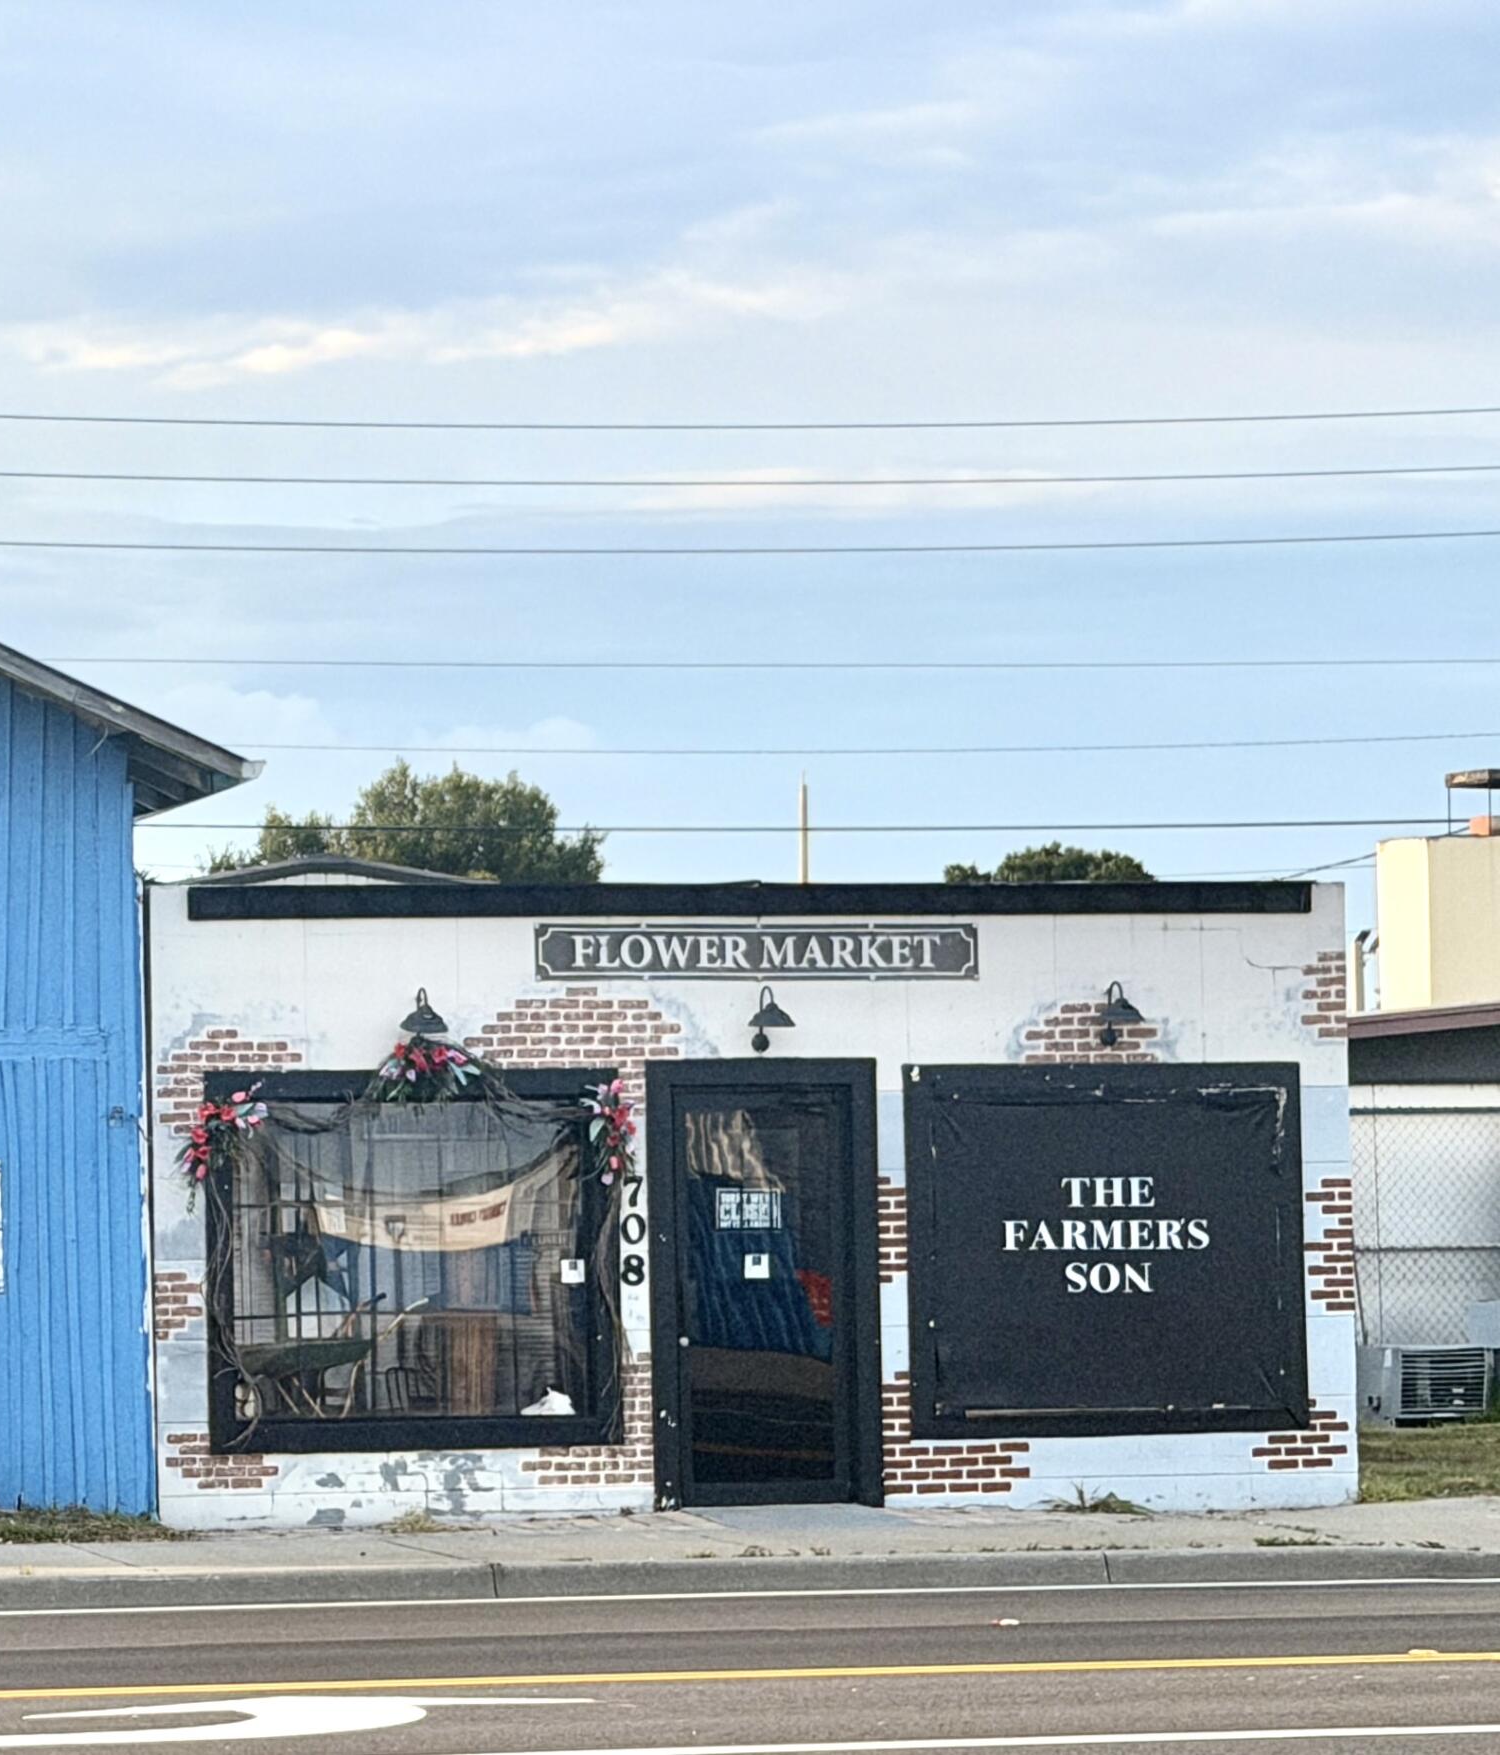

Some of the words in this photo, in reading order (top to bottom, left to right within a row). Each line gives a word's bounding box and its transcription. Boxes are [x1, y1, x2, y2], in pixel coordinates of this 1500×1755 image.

[572, 935, 750, 968] FLOWER
[760, 936, 940, 968] MARKET
[1062, 1177, 1154, 1207] THE
[621, 1176, 646, 1286] 708
[1003, 1219, 1209, 1250] FARMER'S
[1066, 1263, 1152, 1293] SON
